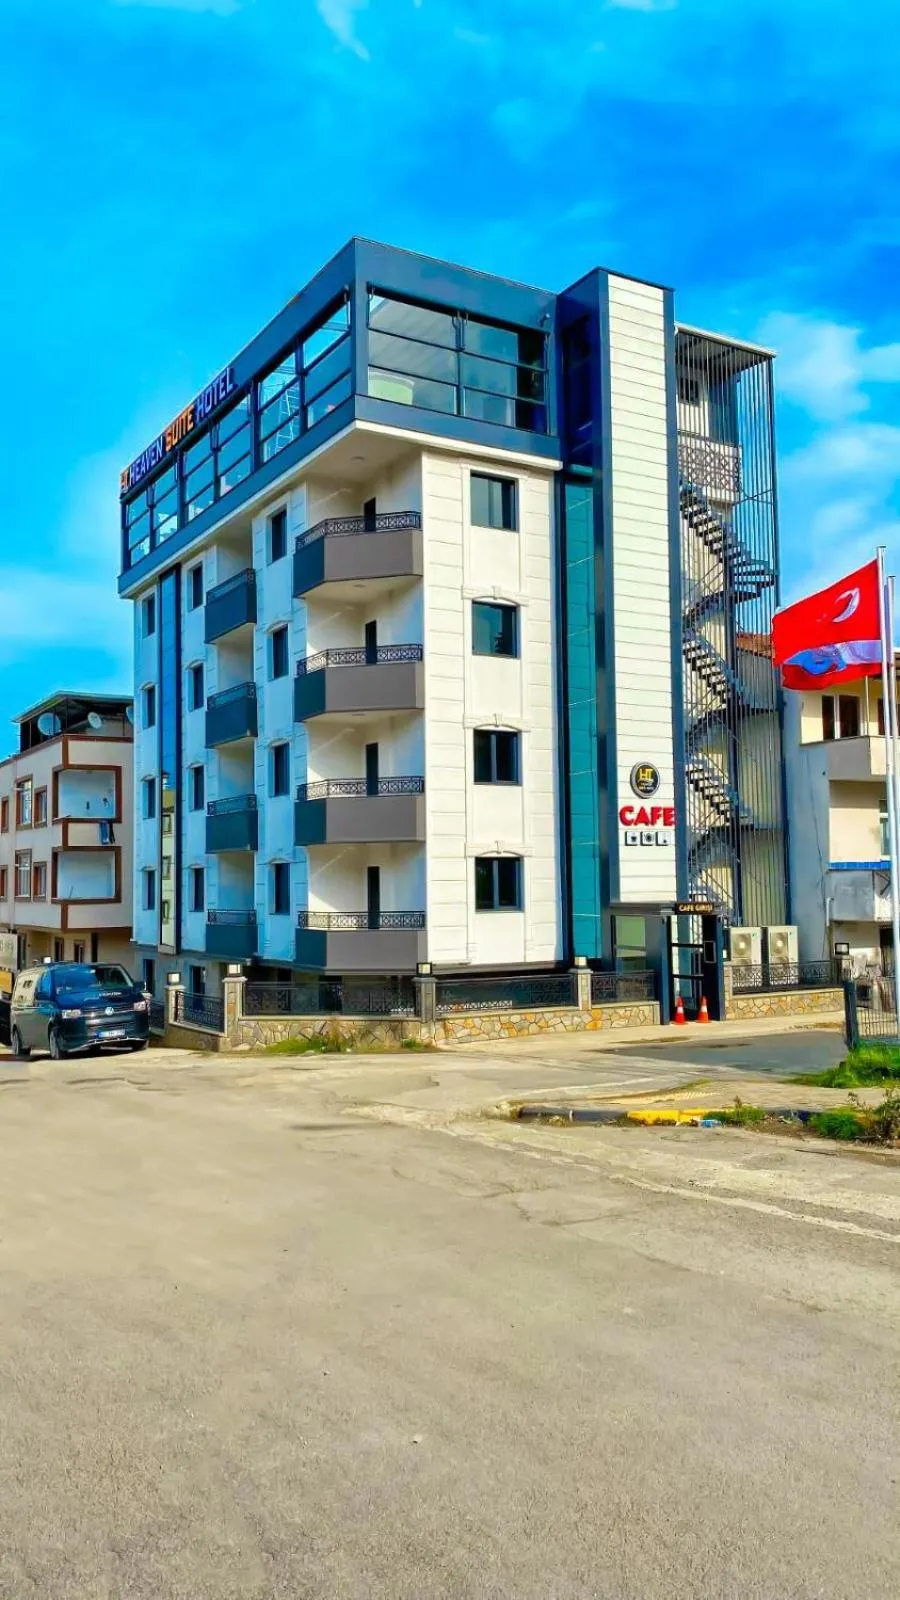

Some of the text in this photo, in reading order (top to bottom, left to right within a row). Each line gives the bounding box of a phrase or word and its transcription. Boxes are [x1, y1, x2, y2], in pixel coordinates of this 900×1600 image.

[130, 436, 163, 487] HEAVEN
[165, 404, 194, 452] SUITE
[195, 367, 234, 422] HOTEL
[619, 805, 675, 826] CAFE
[679, 903, 694, 912] CAFE
